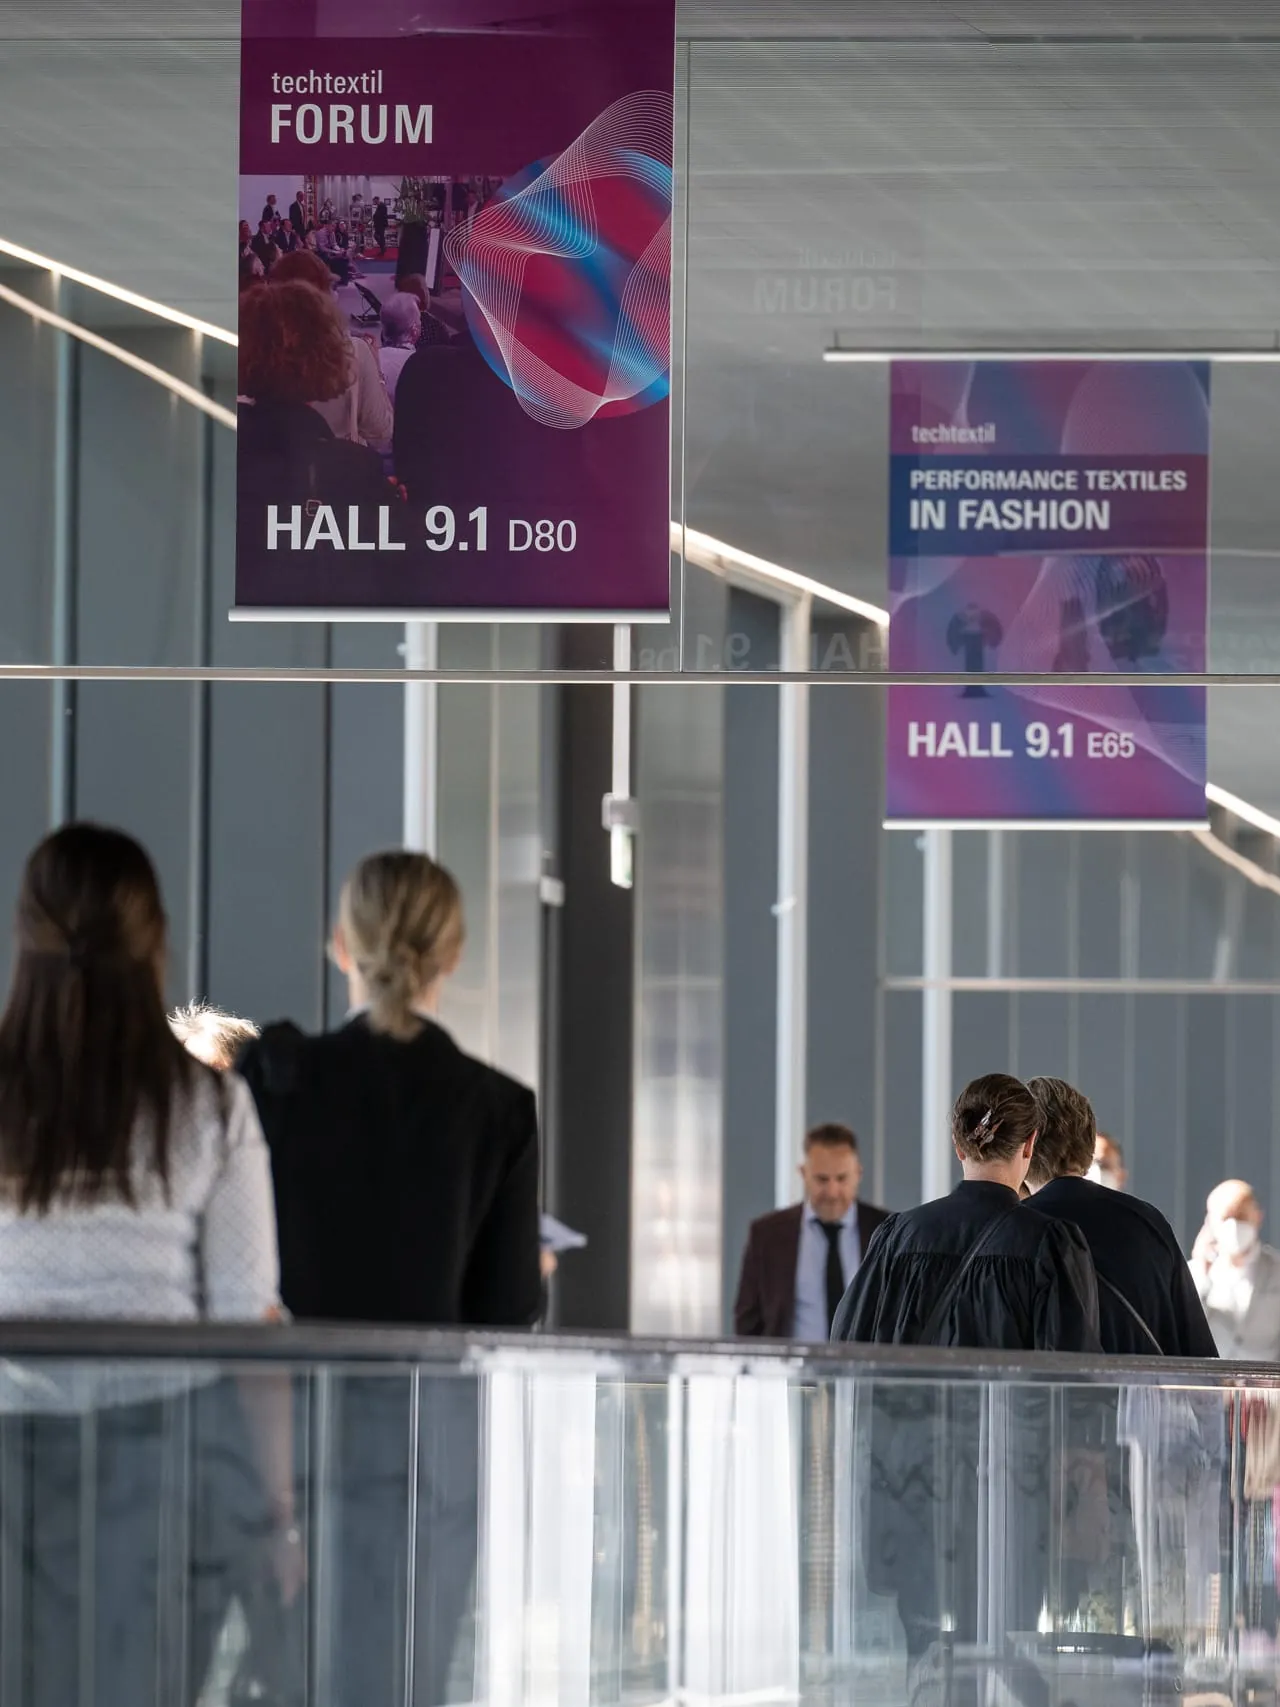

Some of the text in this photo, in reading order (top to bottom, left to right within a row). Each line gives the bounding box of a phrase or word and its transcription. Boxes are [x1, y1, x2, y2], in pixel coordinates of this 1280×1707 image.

[272, 70, 383, 94] techtextil
[271, 104, 433, 144] FORUM
[911, 423, 996, 444] techtextil
[910, 470, 1188, 491] PERFORMANCE TEXTILES
[266, 505, 577, 552] HALL 9.1 D80
[910, 499, 1111, 531] IN FASHION
[907, 722, 1135, 758] HALL 9.1 E65
